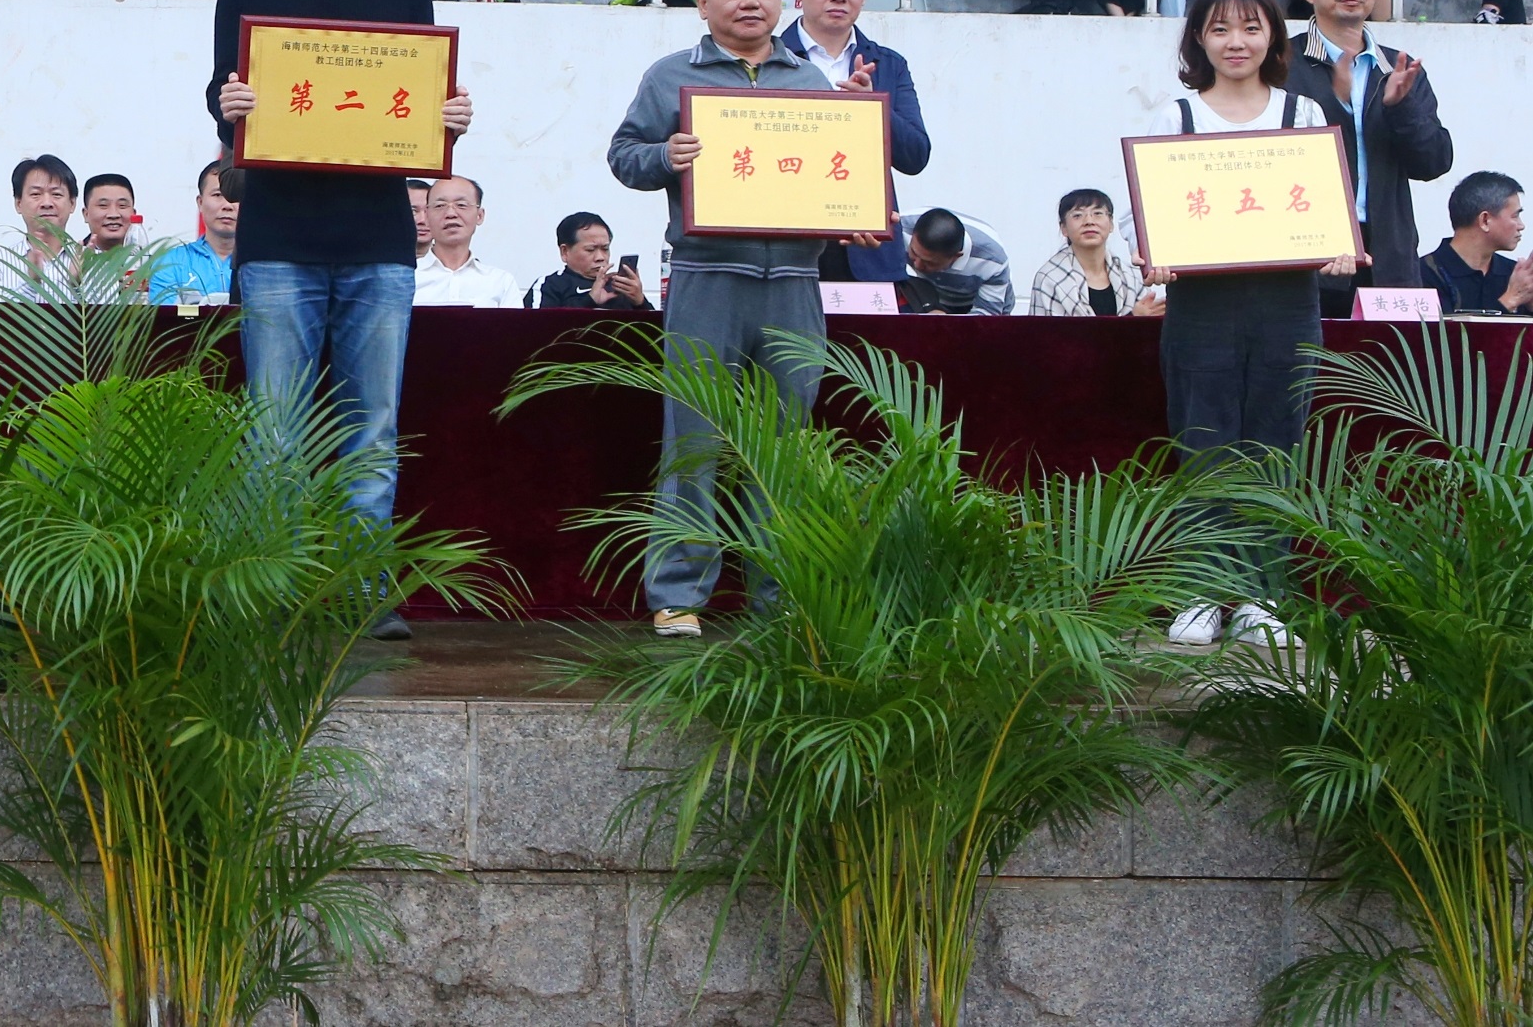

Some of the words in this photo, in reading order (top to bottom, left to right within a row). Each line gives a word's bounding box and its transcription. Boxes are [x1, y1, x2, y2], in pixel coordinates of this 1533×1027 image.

[281, 40, 419, 58] 海南师范大学第三十四届运动会
[315, 55, 383, 69] 教工组团体总分
[289, 79, 411, 119] 第二名
[720, 109, 853, 122] 海南师范大学第三十四届运动会
[753, 122, 820, 133] 教工组团体总分
[1167, 146, 1306, 162] 海南师范大学第三十四届运动会
[732, 146, 850, 182] 第四名
[1204, 161, 1273, 172] 教工组团体总分
[1186, 184, 1311, 220] 第五名
[829, 289, 889, 308] 李森
[1371, 295, 1430, 313] 黄培怡
